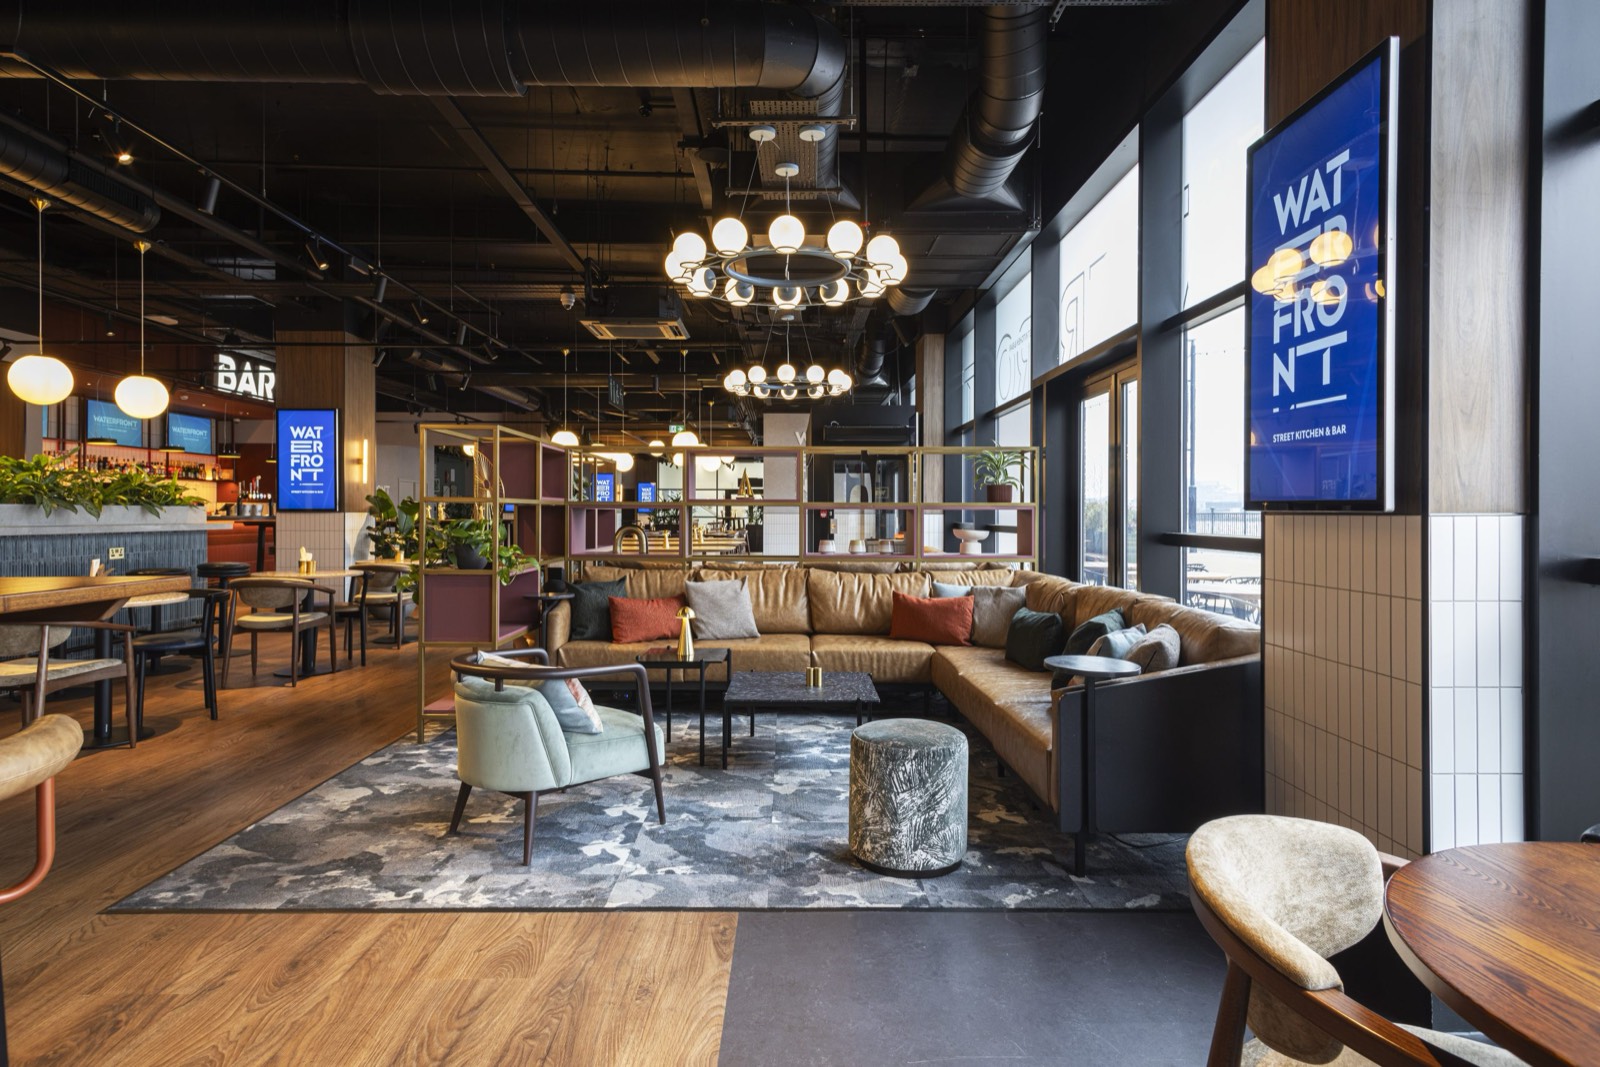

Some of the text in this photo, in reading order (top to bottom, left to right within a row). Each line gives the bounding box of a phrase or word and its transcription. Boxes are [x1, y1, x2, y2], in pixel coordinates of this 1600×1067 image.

[1273, 148, 1350, 236] WAT
[1273, 274, 1348, 345] FRO
[1273, 330, 1348, 397] NT
[217, 353, 276, 403] BAR
[93, 414, 138, 428] WATERFRONT
[172, 426, 208, 437] WATERFRONT
[290, 426, 324, 439] WAT
[1273, 424, 1347, 443] STREET KITCHEN & BAR
[290, 440, 324, 453] ER
[290, 454, 324, 467] FRO
[290, 468, 324, 481] NT
